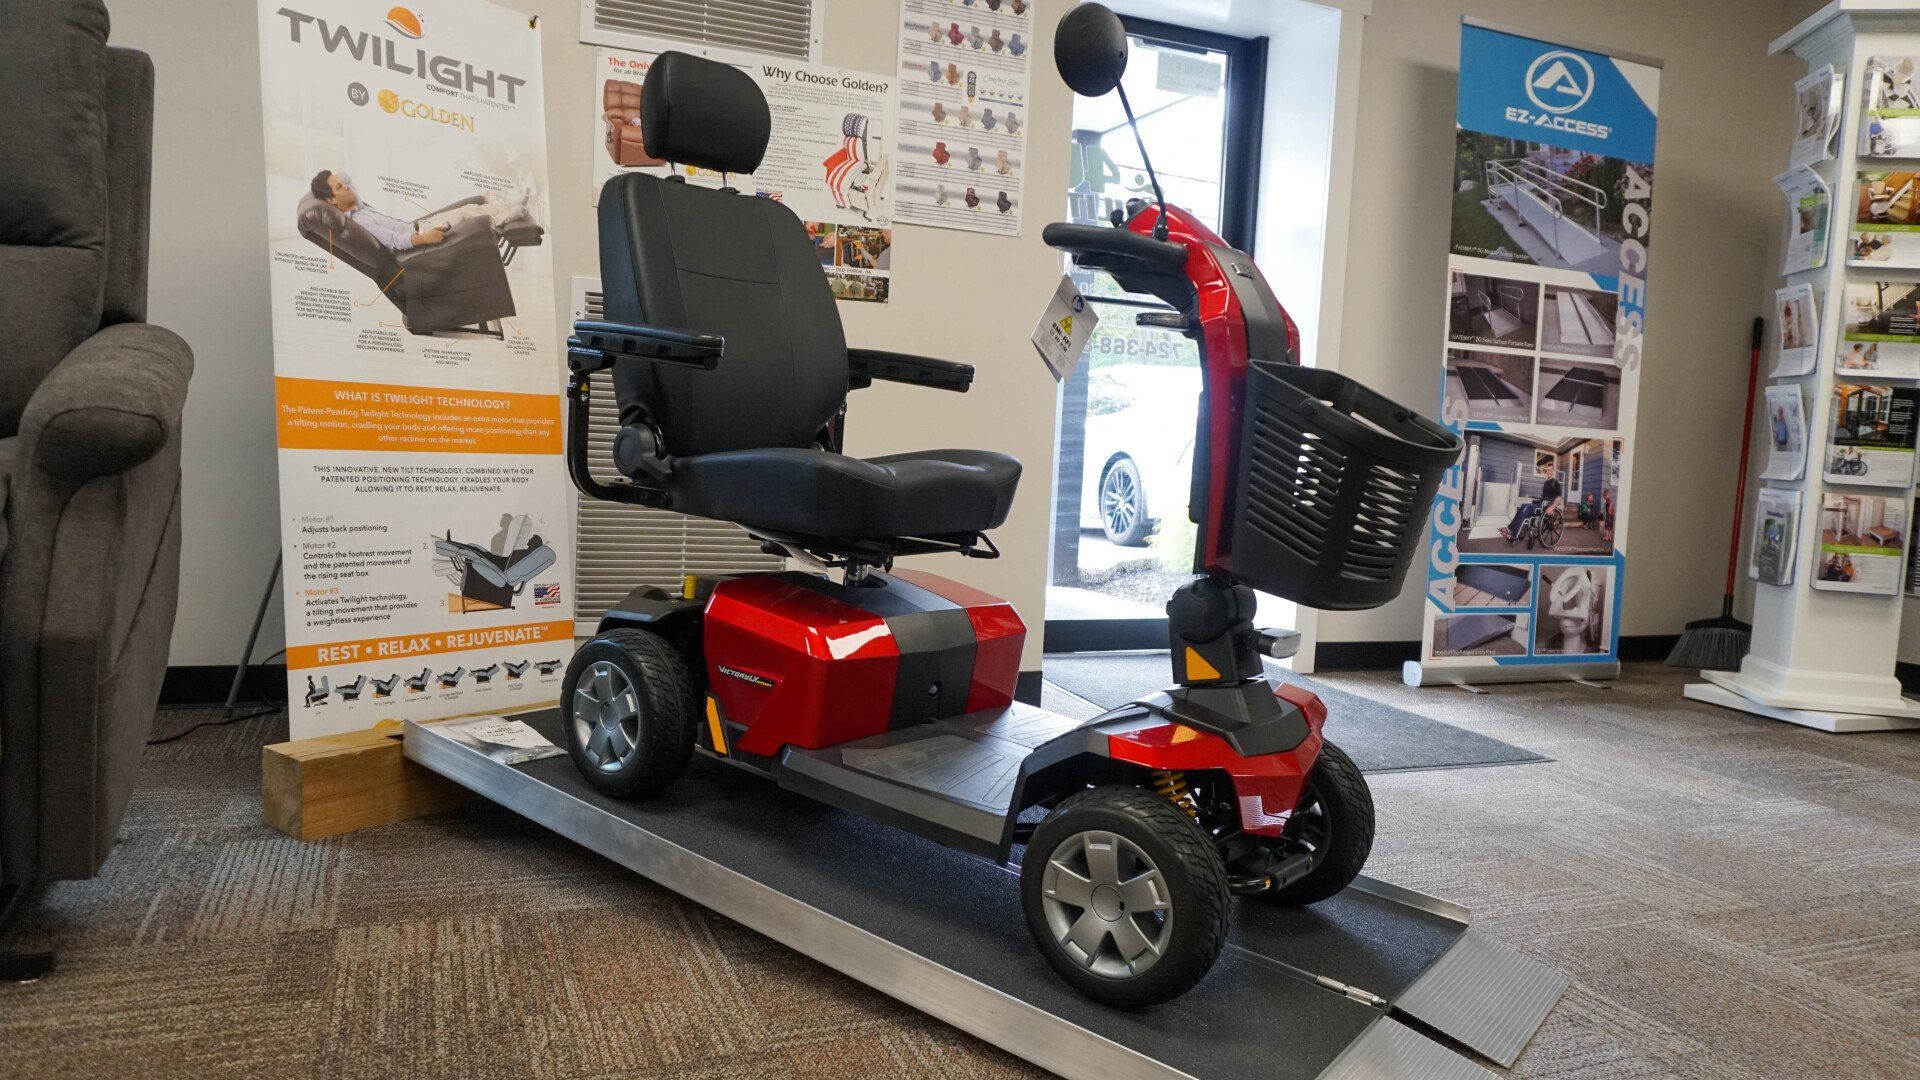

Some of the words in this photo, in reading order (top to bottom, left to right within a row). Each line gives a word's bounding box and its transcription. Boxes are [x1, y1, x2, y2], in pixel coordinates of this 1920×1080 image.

[276, 7, 527, 104] TWILIGHT
[608, 57, 626, 66] The
[762, 65, 791, 82] Why
[795, 70, 838, 86] Choose
[842, 77, 889, 93] Golden?
[351, 88, 366, 101] BY
[426, 84, 458, 97] COMFORT
[401, 100, 475, 132] GOLDEN
[1613, 165, 1651, 372] ACCESS
[334, 391, 368, 402] WHAT
[372, 393, 380, 402] IS
[384, 393, 434, 406] TWILIGHT
[436, 396, 511, 409] TECHNOLOGY?
[282, 405, 296, 413] The
[298, 406, 358, 417] Patent-Pending
[360, 409, 389, 419] Twilight
[390, 411, 431, 421] Technology
[433, 413, 461, 421] includes
[526, 418, 554, 426] provides
[295, 419, 317, 428] tilting
[320, 420, 350, 429] motion,
[352, 421, 382, 431] cradling
[403, 423, 420, 432] body
[422, 424, 436, 432] and
[438, 424, 464, 434] offering
[486, 427, 521, 436] positioning
[302, 526, 329, 534] Adjusts
[349, 524, 387, 533] positioning
[303, 552, 334, 560] Controls
[320, 561, 331, 569] the
[333, 560, 365, 569] patented
[367, 559, 402, 567] movement
[318, 571, 338, 579] rising
[306, 598, 339, 606] Activates
[341, 596, 367, 604] Twilight
[312, 608, 334, 617] tilting
[336, 606, 373, 614] movement
[389, 602, 418, 611] provides
[313, 616, 351, 626] weightless
[353, 614, 391, 623] experience
[318, 645, 361, 663] REST
[378, 638, 431, 656] RELAX
